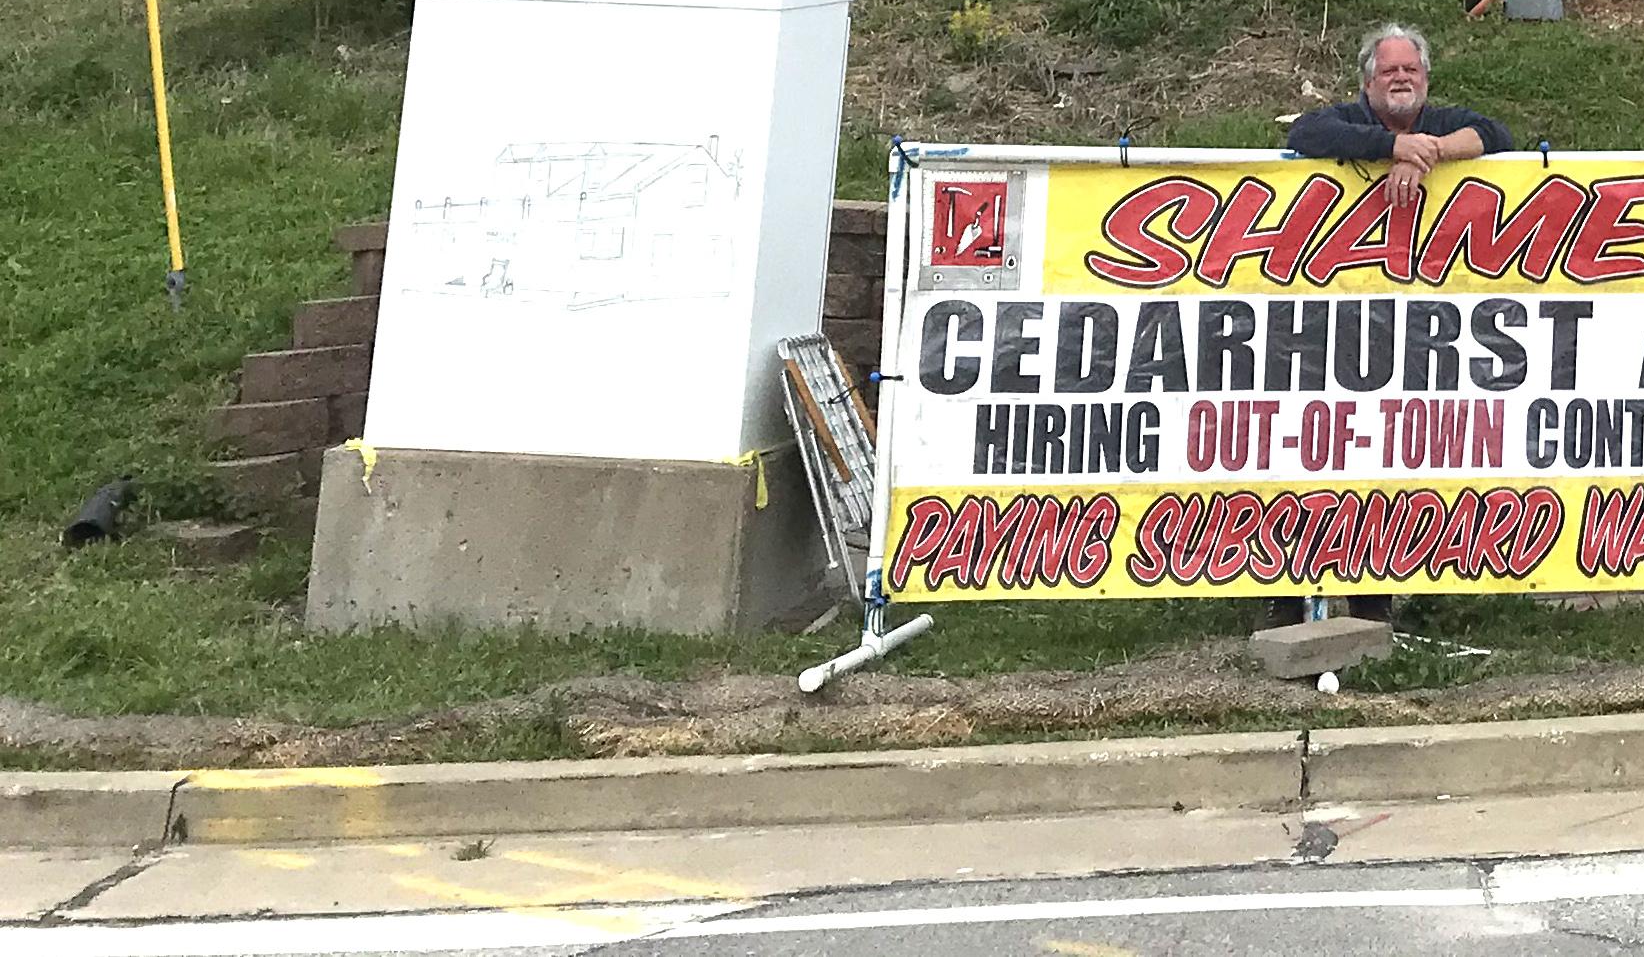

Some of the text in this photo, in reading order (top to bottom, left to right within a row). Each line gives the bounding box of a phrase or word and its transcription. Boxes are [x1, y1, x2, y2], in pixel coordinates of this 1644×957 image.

[918, 298, 1594, 395] CEDARHURST
[972, 400, 1160, 476] HIRING
[1186, 398, 1504, 472] OUT-OF-TOWN
[890, 493, 1119, 590] PAYING
[1125, 487, 1564, 586] SUBSTANDARD
